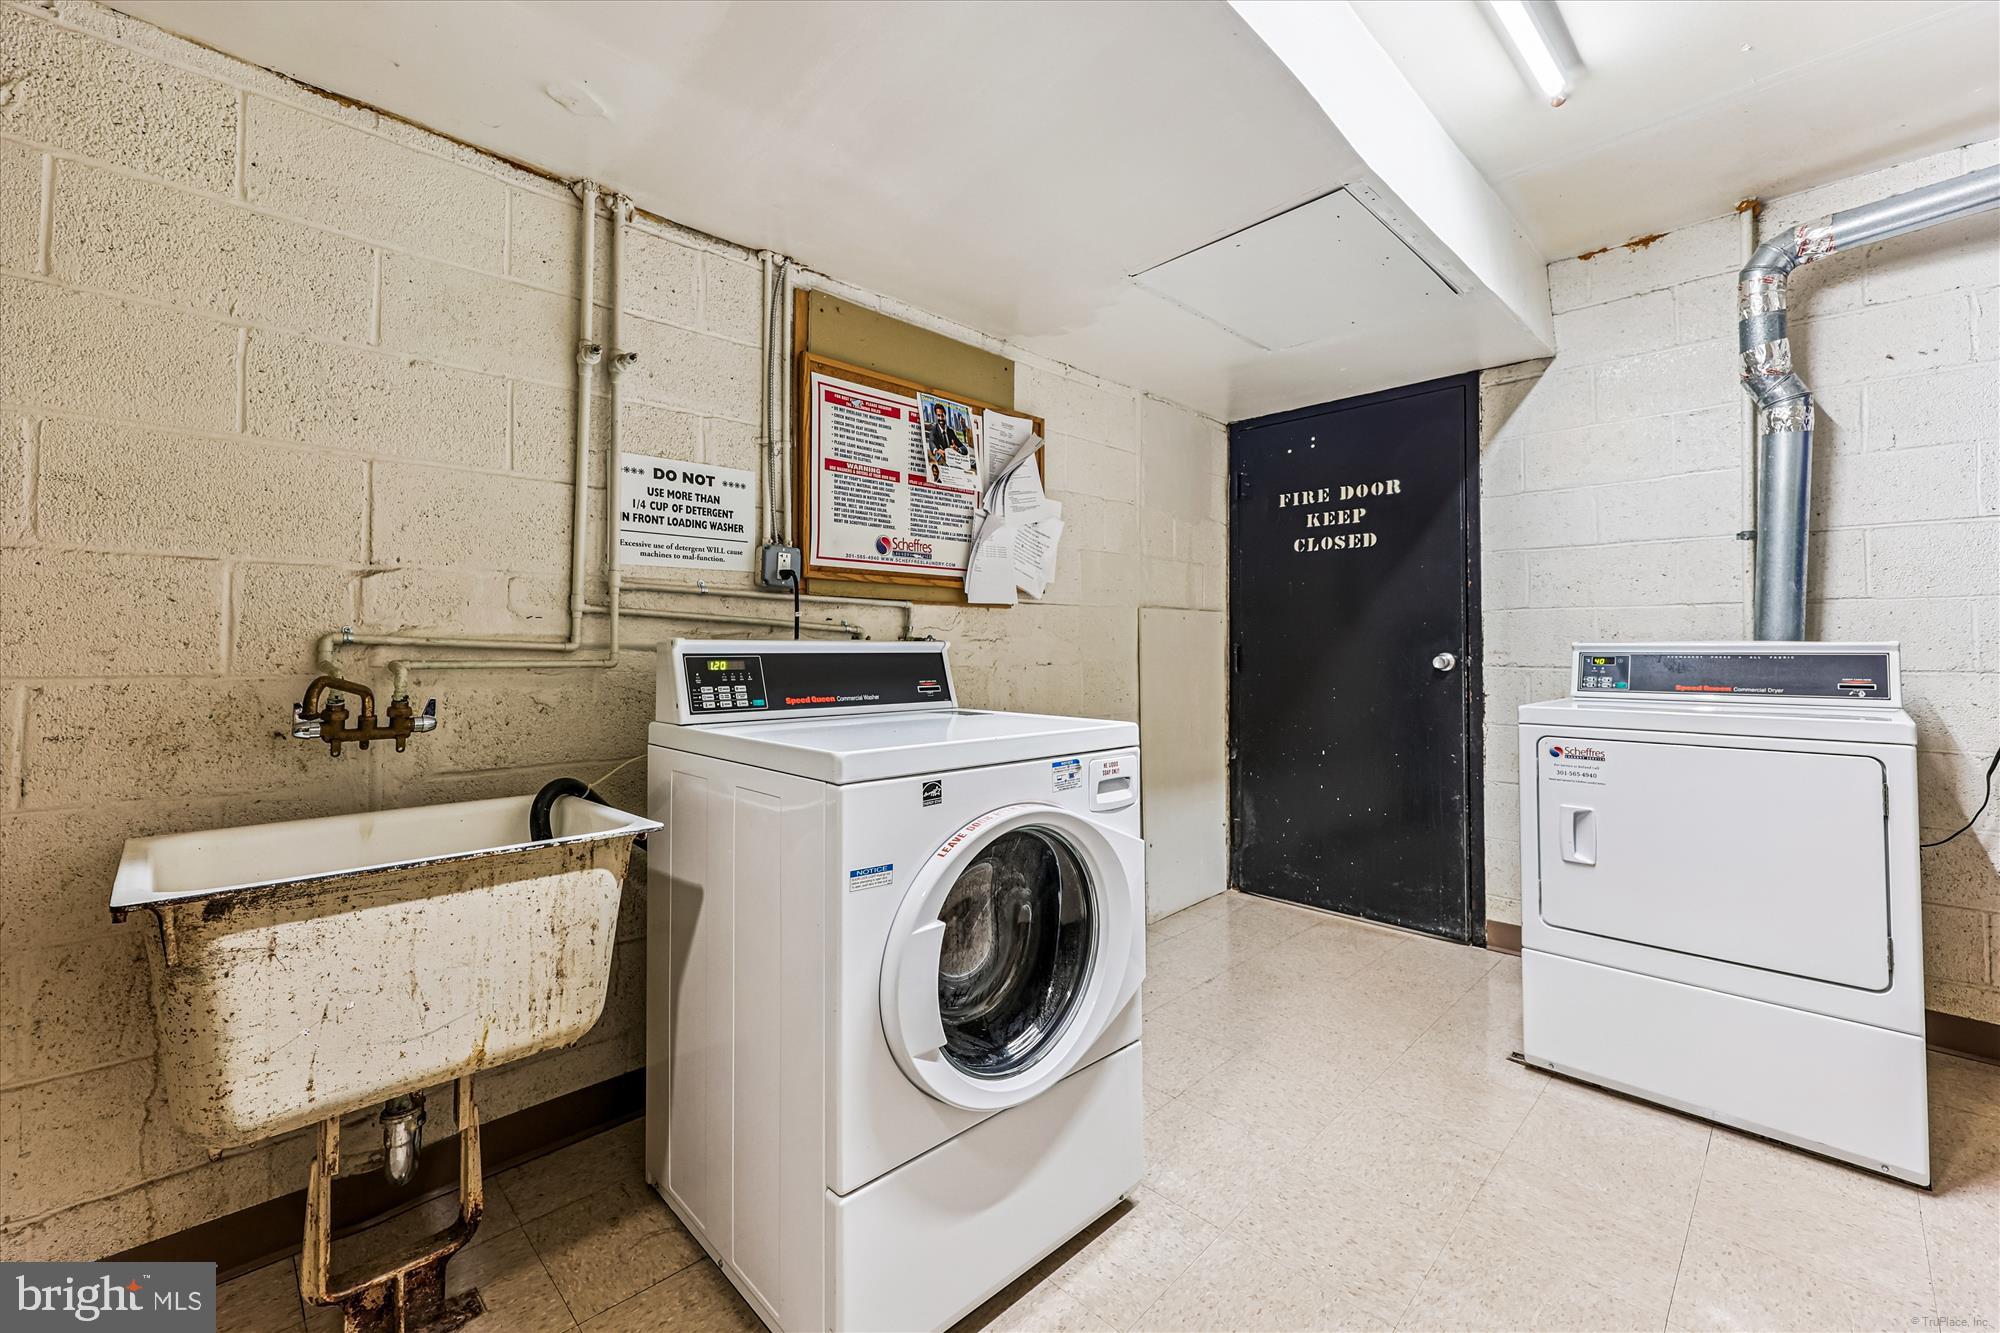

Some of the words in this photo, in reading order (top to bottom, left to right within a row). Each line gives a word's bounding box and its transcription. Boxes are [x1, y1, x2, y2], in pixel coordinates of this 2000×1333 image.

[847, 462, 880, 474] WARNING
[653, 468, 677, 481] DO
[683, 472, 715, 487] NOT
[647, 487, 664, 497] USE
[667, 489, 692, 501] MORE
[695, 493, 720, 504] THAN
[1279, 488, 1330, 508] FIRE
[1340, 479, 1401, 500] DOOR
[632, 499, 646, 510] 1/4
[650, 501, 668, 512] CUP
[672, 504, 683, 513] OF
[686, 506, 733, 519] DETERGENT
[1306, 508, 1366, 528] KEEP
[633, 513, 664, 525] FRONT
[668, 516, 707, 530] LOADING
[710, 521, 744, 533] WASHER
[620, 539, 651, 548] Excessive
[675, 545, 705, 554] detergent
[893, 538, 932, 553] Scheffres
[1294, 532, 1377, 552] CLOSED
[786, 696, 810, 705] Speed
[1565, 747, 1605, 758] Scheffres
[937, 833, 967, 858] LEAVE
[857, 866, 887, 876] NOTICE
